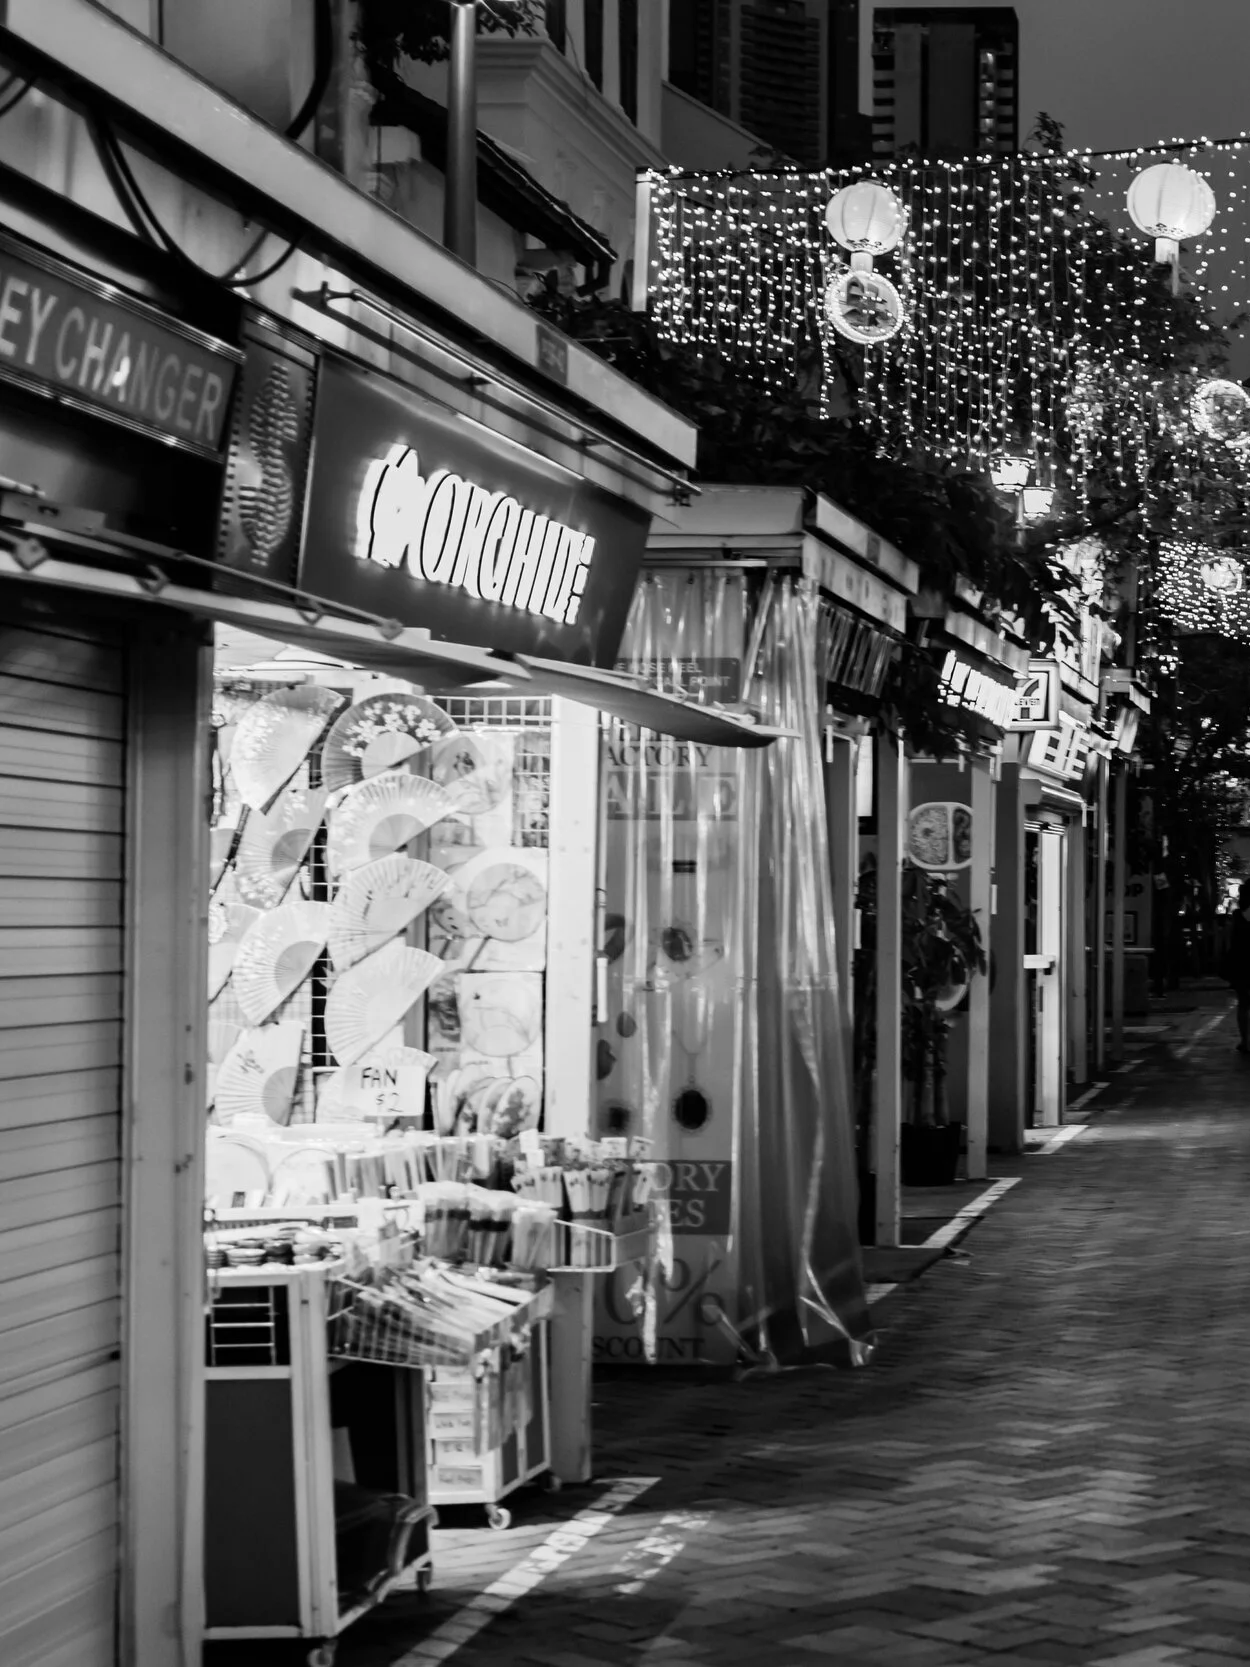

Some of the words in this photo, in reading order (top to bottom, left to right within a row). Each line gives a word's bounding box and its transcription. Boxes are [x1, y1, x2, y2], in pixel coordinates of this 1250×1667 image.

[55, 307, 223, 441] CHANGER
[608, 745, 713, 767] ACTORY
[361, 1067, 397, 1089] FAN
